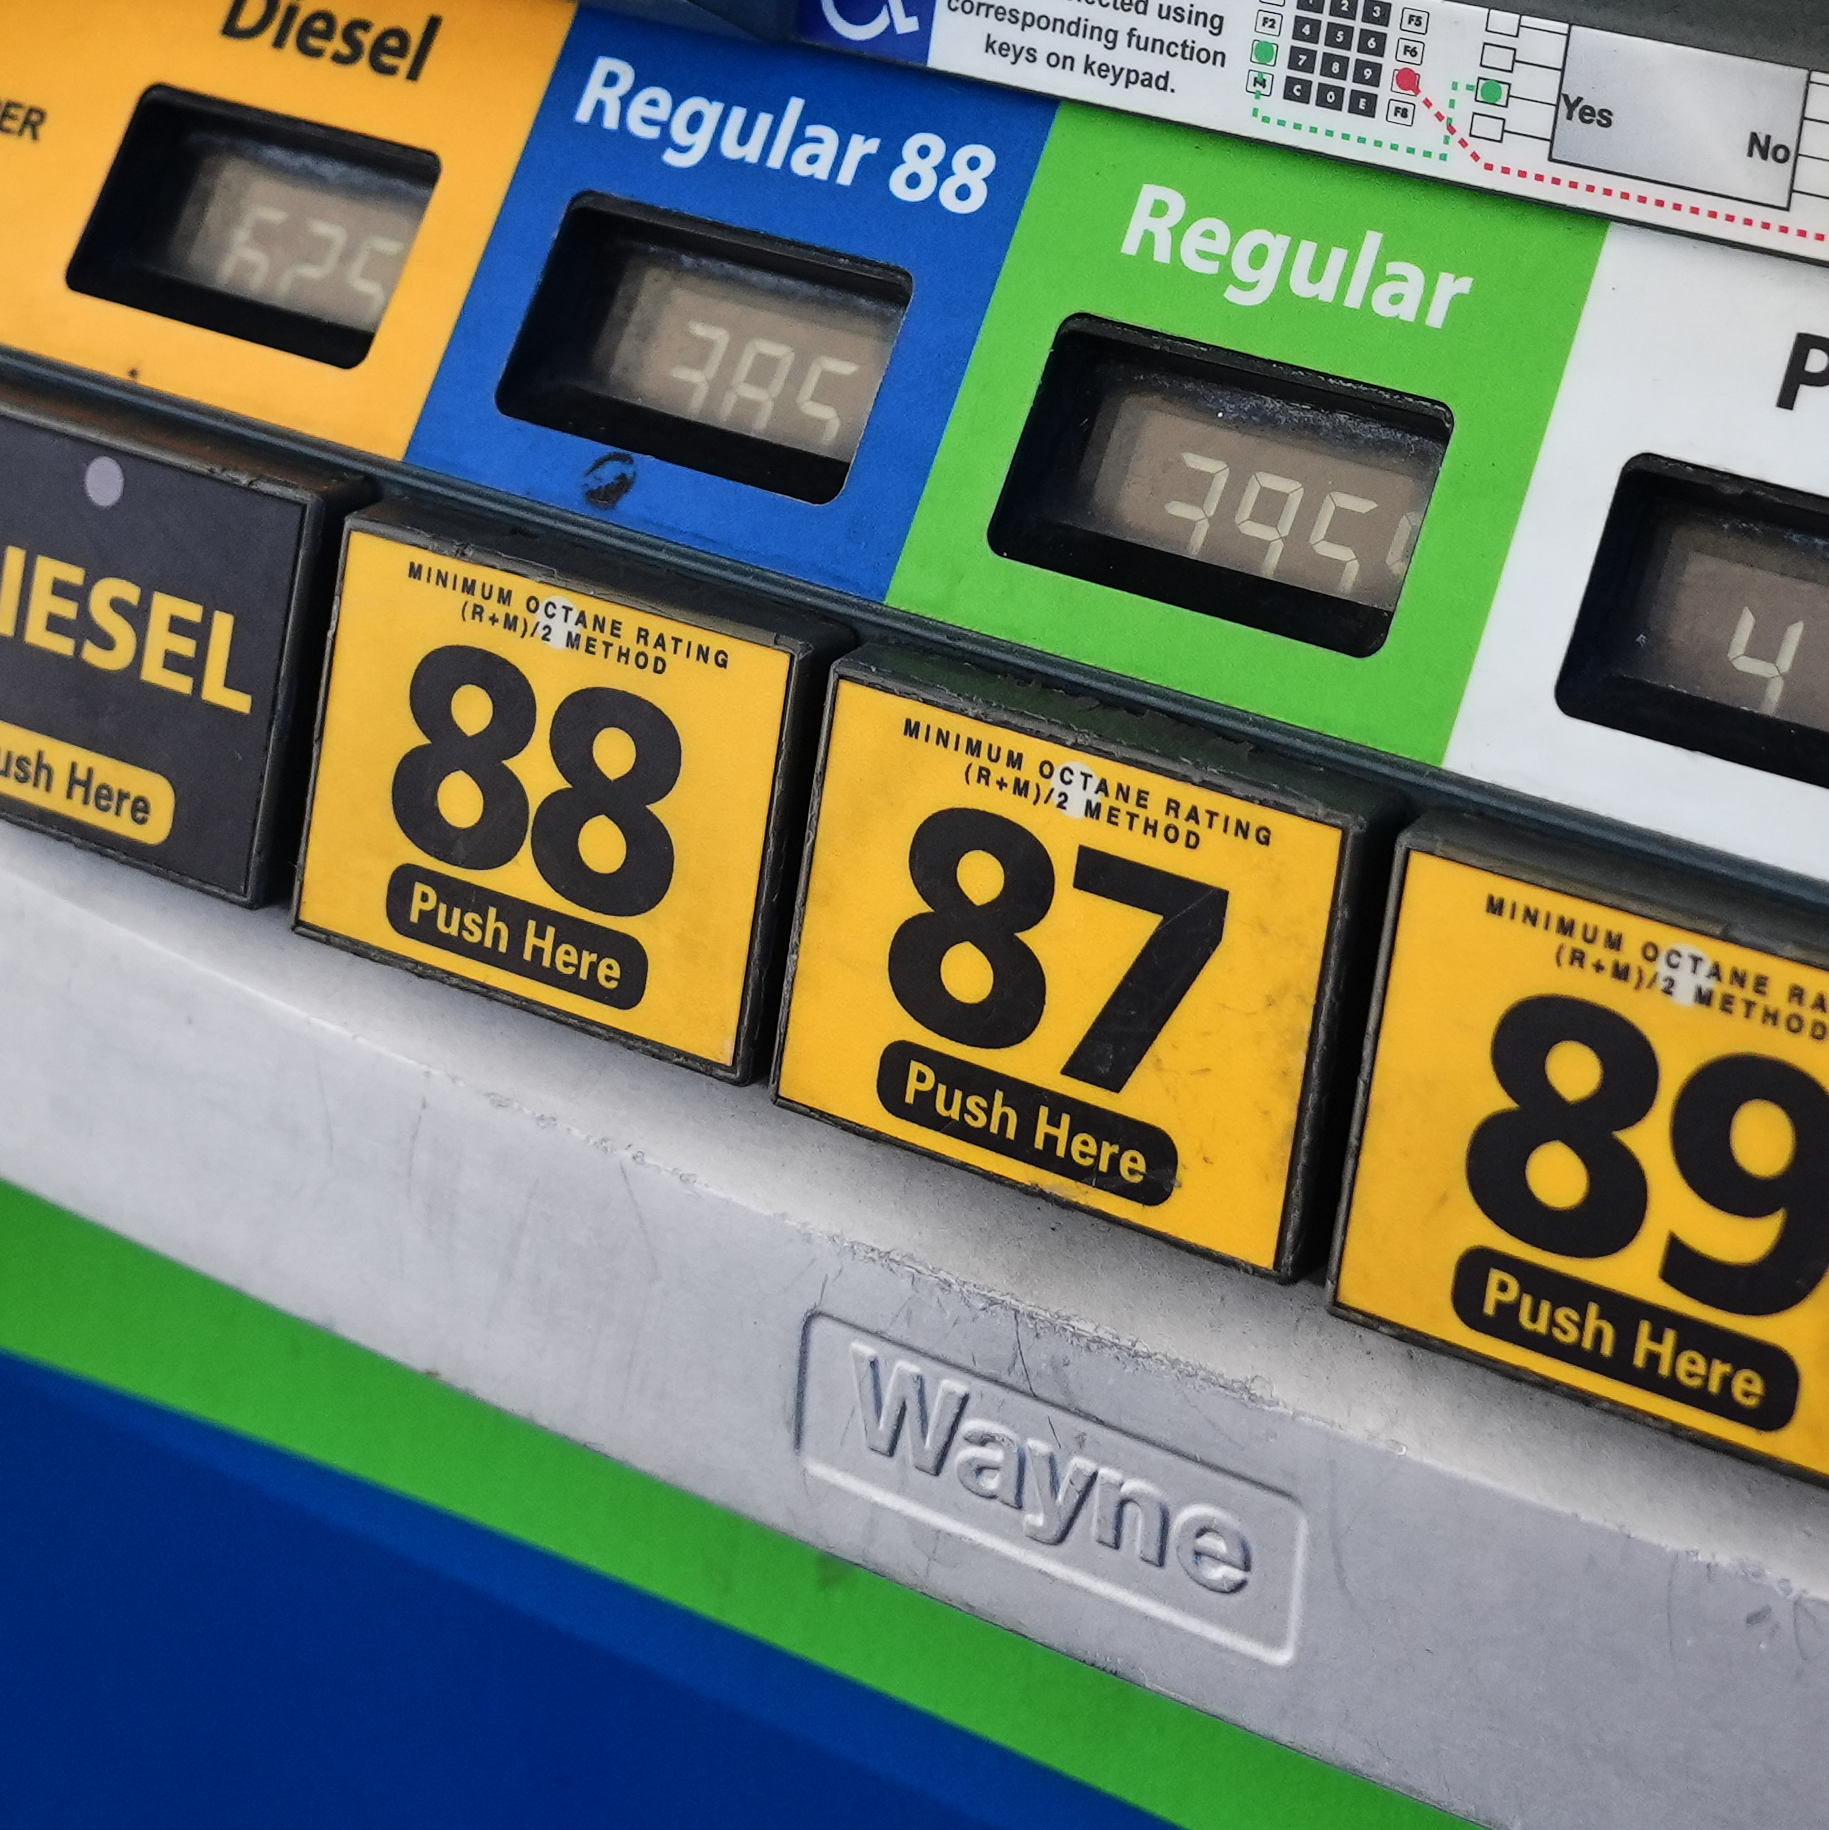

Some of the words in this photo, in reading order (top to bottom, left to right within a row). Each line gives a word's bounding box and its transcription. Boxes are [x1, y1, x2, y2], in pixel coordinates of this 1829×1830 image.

[1157, 4, 1225, 37] using
[1262, 16, 1276, 29] F2
[1301, 24, 1310, 35] 4
[1341, 0, 1349, 11] 2
[1373, 6, 1381, 17] 3
[1408, 14, 1423, 27] F5
[984, 34, 1038, 65] keys
[1046, 51, 1075, 72] on
[1083, 55, 1176, 94] keypad.
[1126, 28, 1226, 68] function
[1298, 55, 1307, 66] 7
[1336, 31, 1344, 42] 5
[1367, 37, 1376, 49] 6
[1332, 62, 1340, 74] 8
[1364, 68, 1372, 80] 9
[575, 56, 880, 186] Regular
[889, 132, 997, 214] 88
[1562, 93, 1613, 129] Yes
[1747, 132, 1790, 165] No
[1120, 184, 1474, 329] Regular
[407, 561, 514, 608] MINIMUM
[526, 595, 624, 640] OCTANE
[636, 626, 731, 670] RATING
[460, 600, 554, 644] (R+M)/2
[566, 631, 668, 676] METHOD
[65, 761, 152, 825] Here
[391, 644, 683, 917] 88
[903, 718, 1026, 771] MINIMUM
[1038, 759, 1150, 810] OCTANE
[1165, 797, 1273, 847] RATING
[964, 763, 1070, 812] (R+M)/2
[1084, 799, 1202, 851] METHOD
[408, 880, 509, 953] Push
[522, 919, 622, 990] Here
[887, 806, 1230, 1094] 87
[1484, 892, 1624, 953] MINIMUM
[1640, 941, 1770, 997] OCTANE
[1555, 943, 1677, 996] (R+M)/2
[904, 1059, 1018, 1141] Push
[1033, 1104, 1148, 1185] Here
[1482, 1265, 1615, 1359] Push
[1631, 1317, 1767, 1411] Here
[850, 1341, 1252, 1594] Wayne
